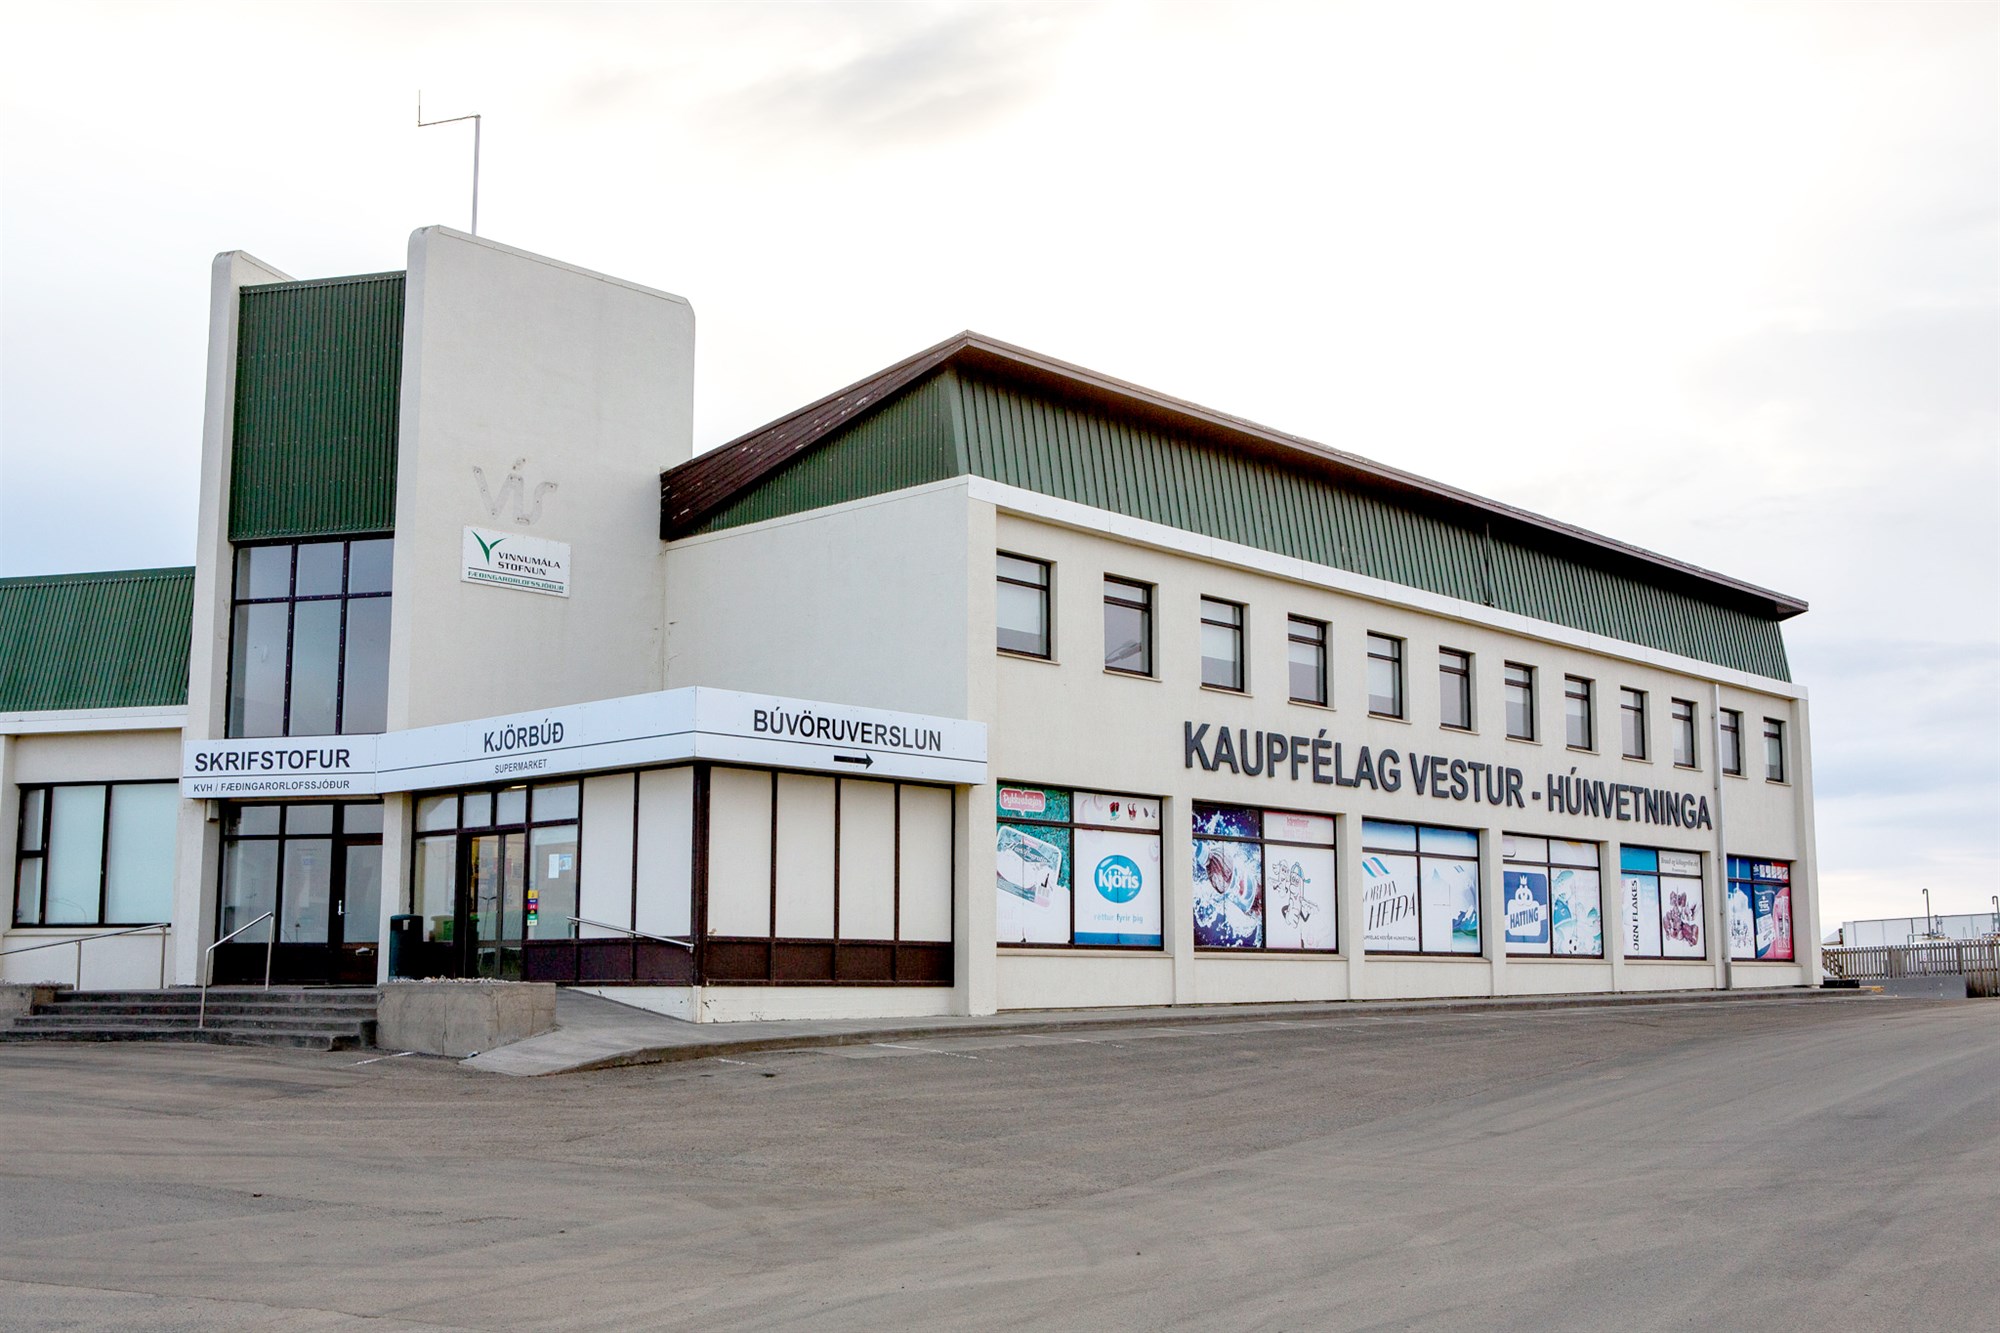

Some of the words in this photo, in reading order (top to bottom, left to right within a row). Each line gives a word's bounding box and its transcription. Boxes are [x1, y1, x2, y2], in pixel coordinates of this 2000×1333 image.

[498, 551, 561, 569] VINNUMÁLA
[498, 561, 547, 576] STOFNUN
[483, 718, 564, 753] KJÖRBÚÐ
[753, 706, 942, 752] BÚVÖRUVERSLUN
[194, 749, 351, 772] SKRIFSTOFUR
[494, 758, 548, 774] SUPERMARKET
[193, 783, 213, 793] KVH
[220, 778, 350, 792] FÆÐINGARORLOFSSJÓÐUR
[1184, 720, 1402, 793] KAUPFÉLAG
[1409, 752, 1526, 808] VESTUR
[1546, 767, 1713, 831] HÚNVETNINGA
[1631, 880, 1639, 922] FLAKES
[1509, 907, 1539, 929] HATTING
[1632, 924, 1640, 952] ORN
